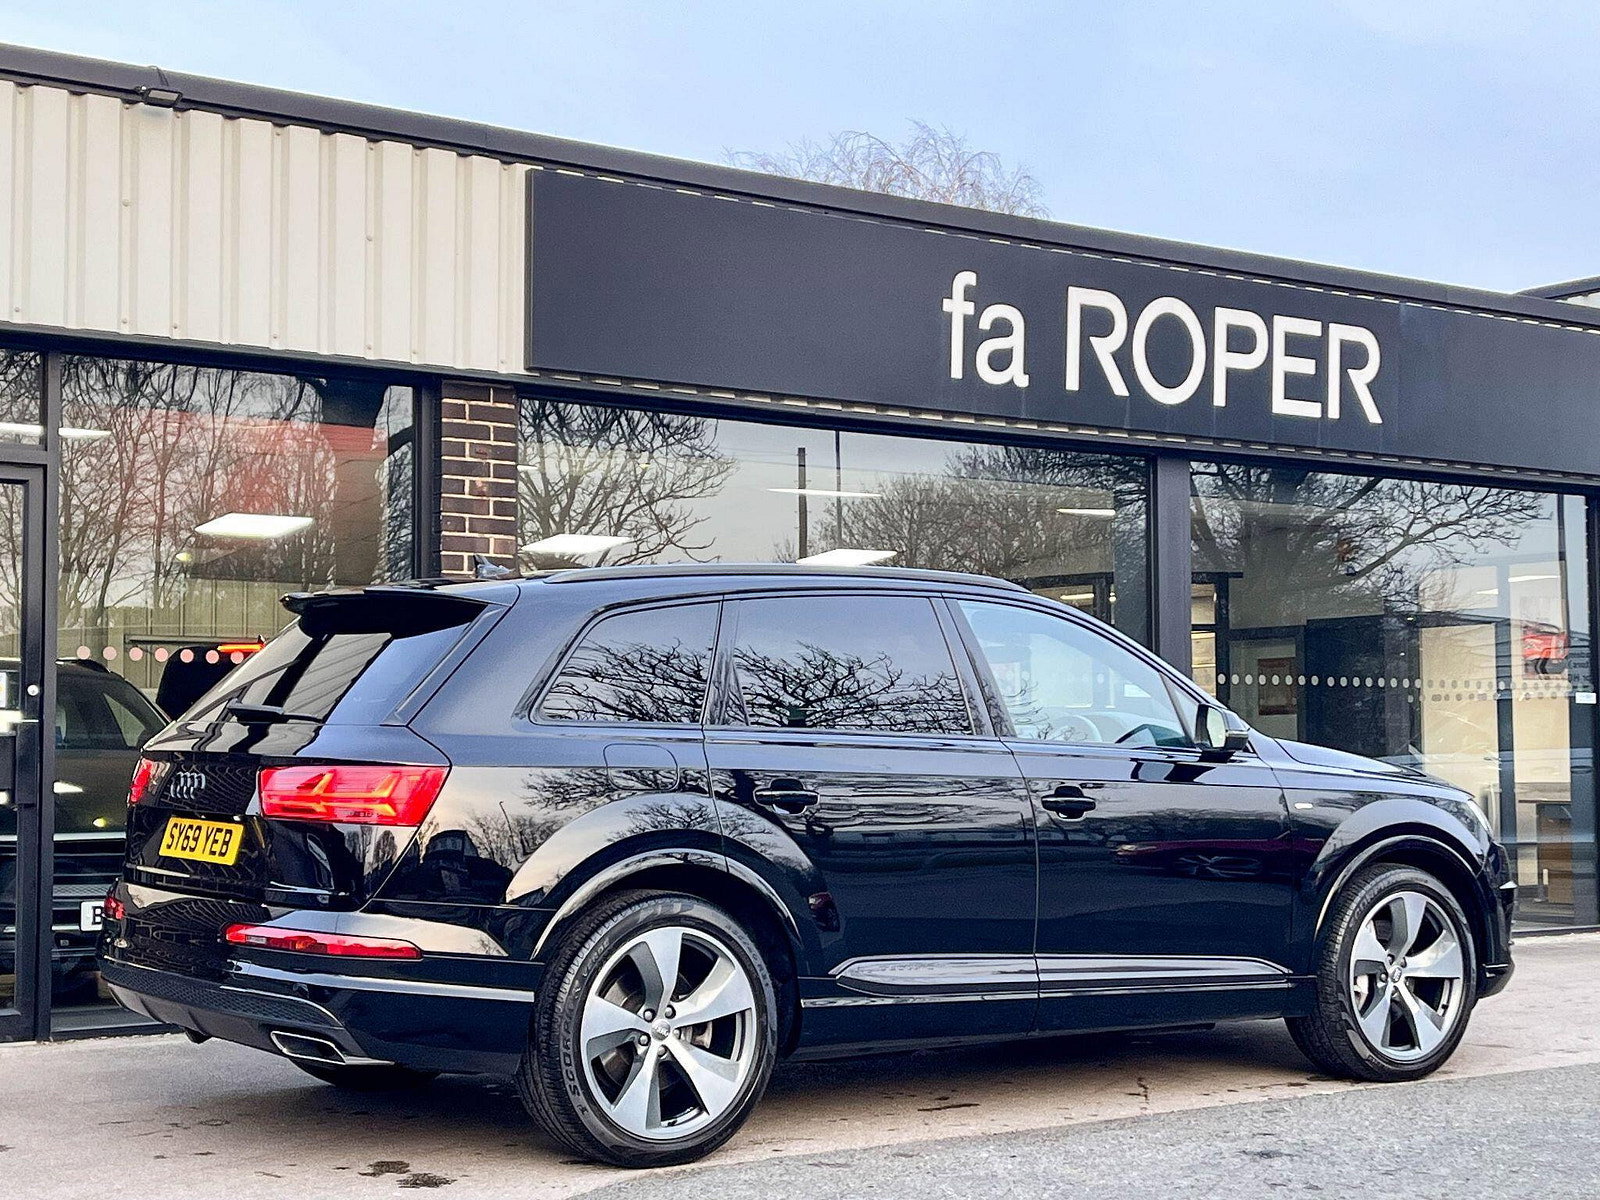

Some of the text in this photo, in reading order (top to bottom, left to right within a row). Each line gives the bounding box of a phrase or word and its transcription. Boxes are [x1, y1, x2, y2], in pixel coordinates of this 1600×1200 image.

[943, 271, 1383, 425] fa ROPER
[166, 822, 232, 857] SY69 YEB
